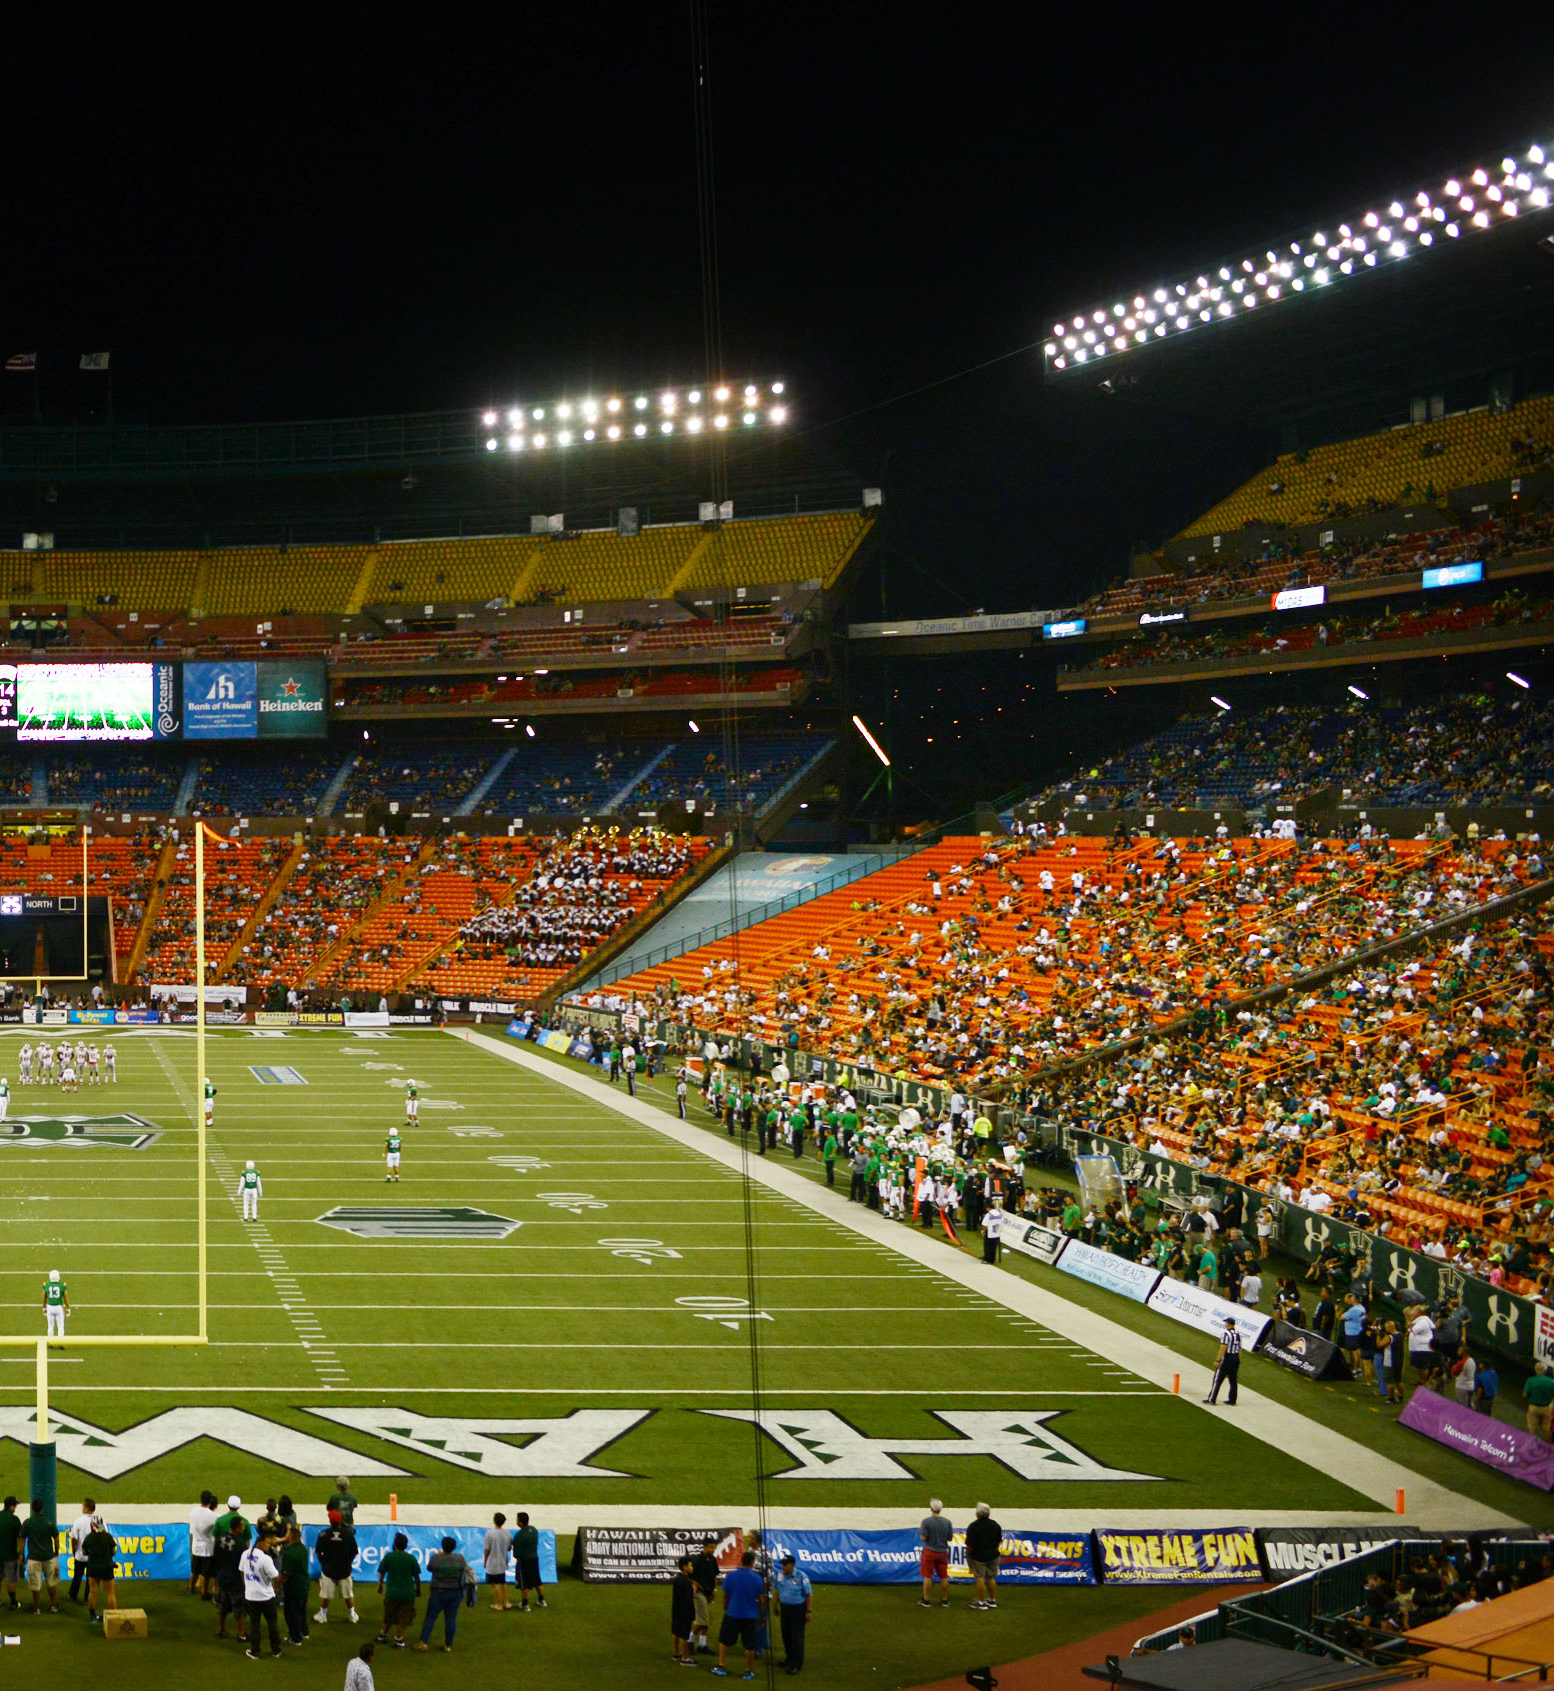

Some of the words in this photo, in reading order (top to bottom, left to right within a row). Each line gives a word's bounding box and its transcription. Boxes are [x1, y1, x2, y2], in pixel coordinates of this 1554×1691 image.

[1278, 595, 1303, 609] MIDAS
[157, 665, 168, 713] Oceanic
[188, 702, 210, 711] Bank
[212, 701, 221, 711] of
[223, 700, 252, 710] Hawaii
[259, 700, 322, 713] Heineken
[26, 900, 53, 909] NORTH
[4, 1014, 20, 1022] Bank
[299, 1013, 325, 1022] XTREME
[328, 1013, 342, 1022] FUN
[536, 1191, 608, 1209] 30
[597, 1237, 684, 1259] 20
[48, 1285, 61, 1299] 13
[674, 1296, 775, 1321] 10
[1263, 1341, 1279, 1356] First
[1277, 1347, 1303, 1366] Hawaiian
[1479, 1439, 1508, 1461] Telcom
[585, 1529, 668, 1541] HAWAII'S
[674, 1531, 720, 1541] OWN
[586, 1541, 611, 1555] ARMY
[611, 1542, 654, 1556] NATIONAL
[655, 1543, 686, 1557] GUARD
[797, 1549, 844, 1563] Bank
[846, 1548, 865, 1563] of
[1036, 1541, 1084, 1559] PARTS
[1100, 1533, 1199, 1567] XTREME
[1206, 1532, 1260, 1567] FUN
[1265, 1541, 1357, 1570] MUSCLE
[587, 1557, 602, 1566] YOU
[603, 1557, 619, 1566] CAN
[134, 1569, 150, 1578] LLC
